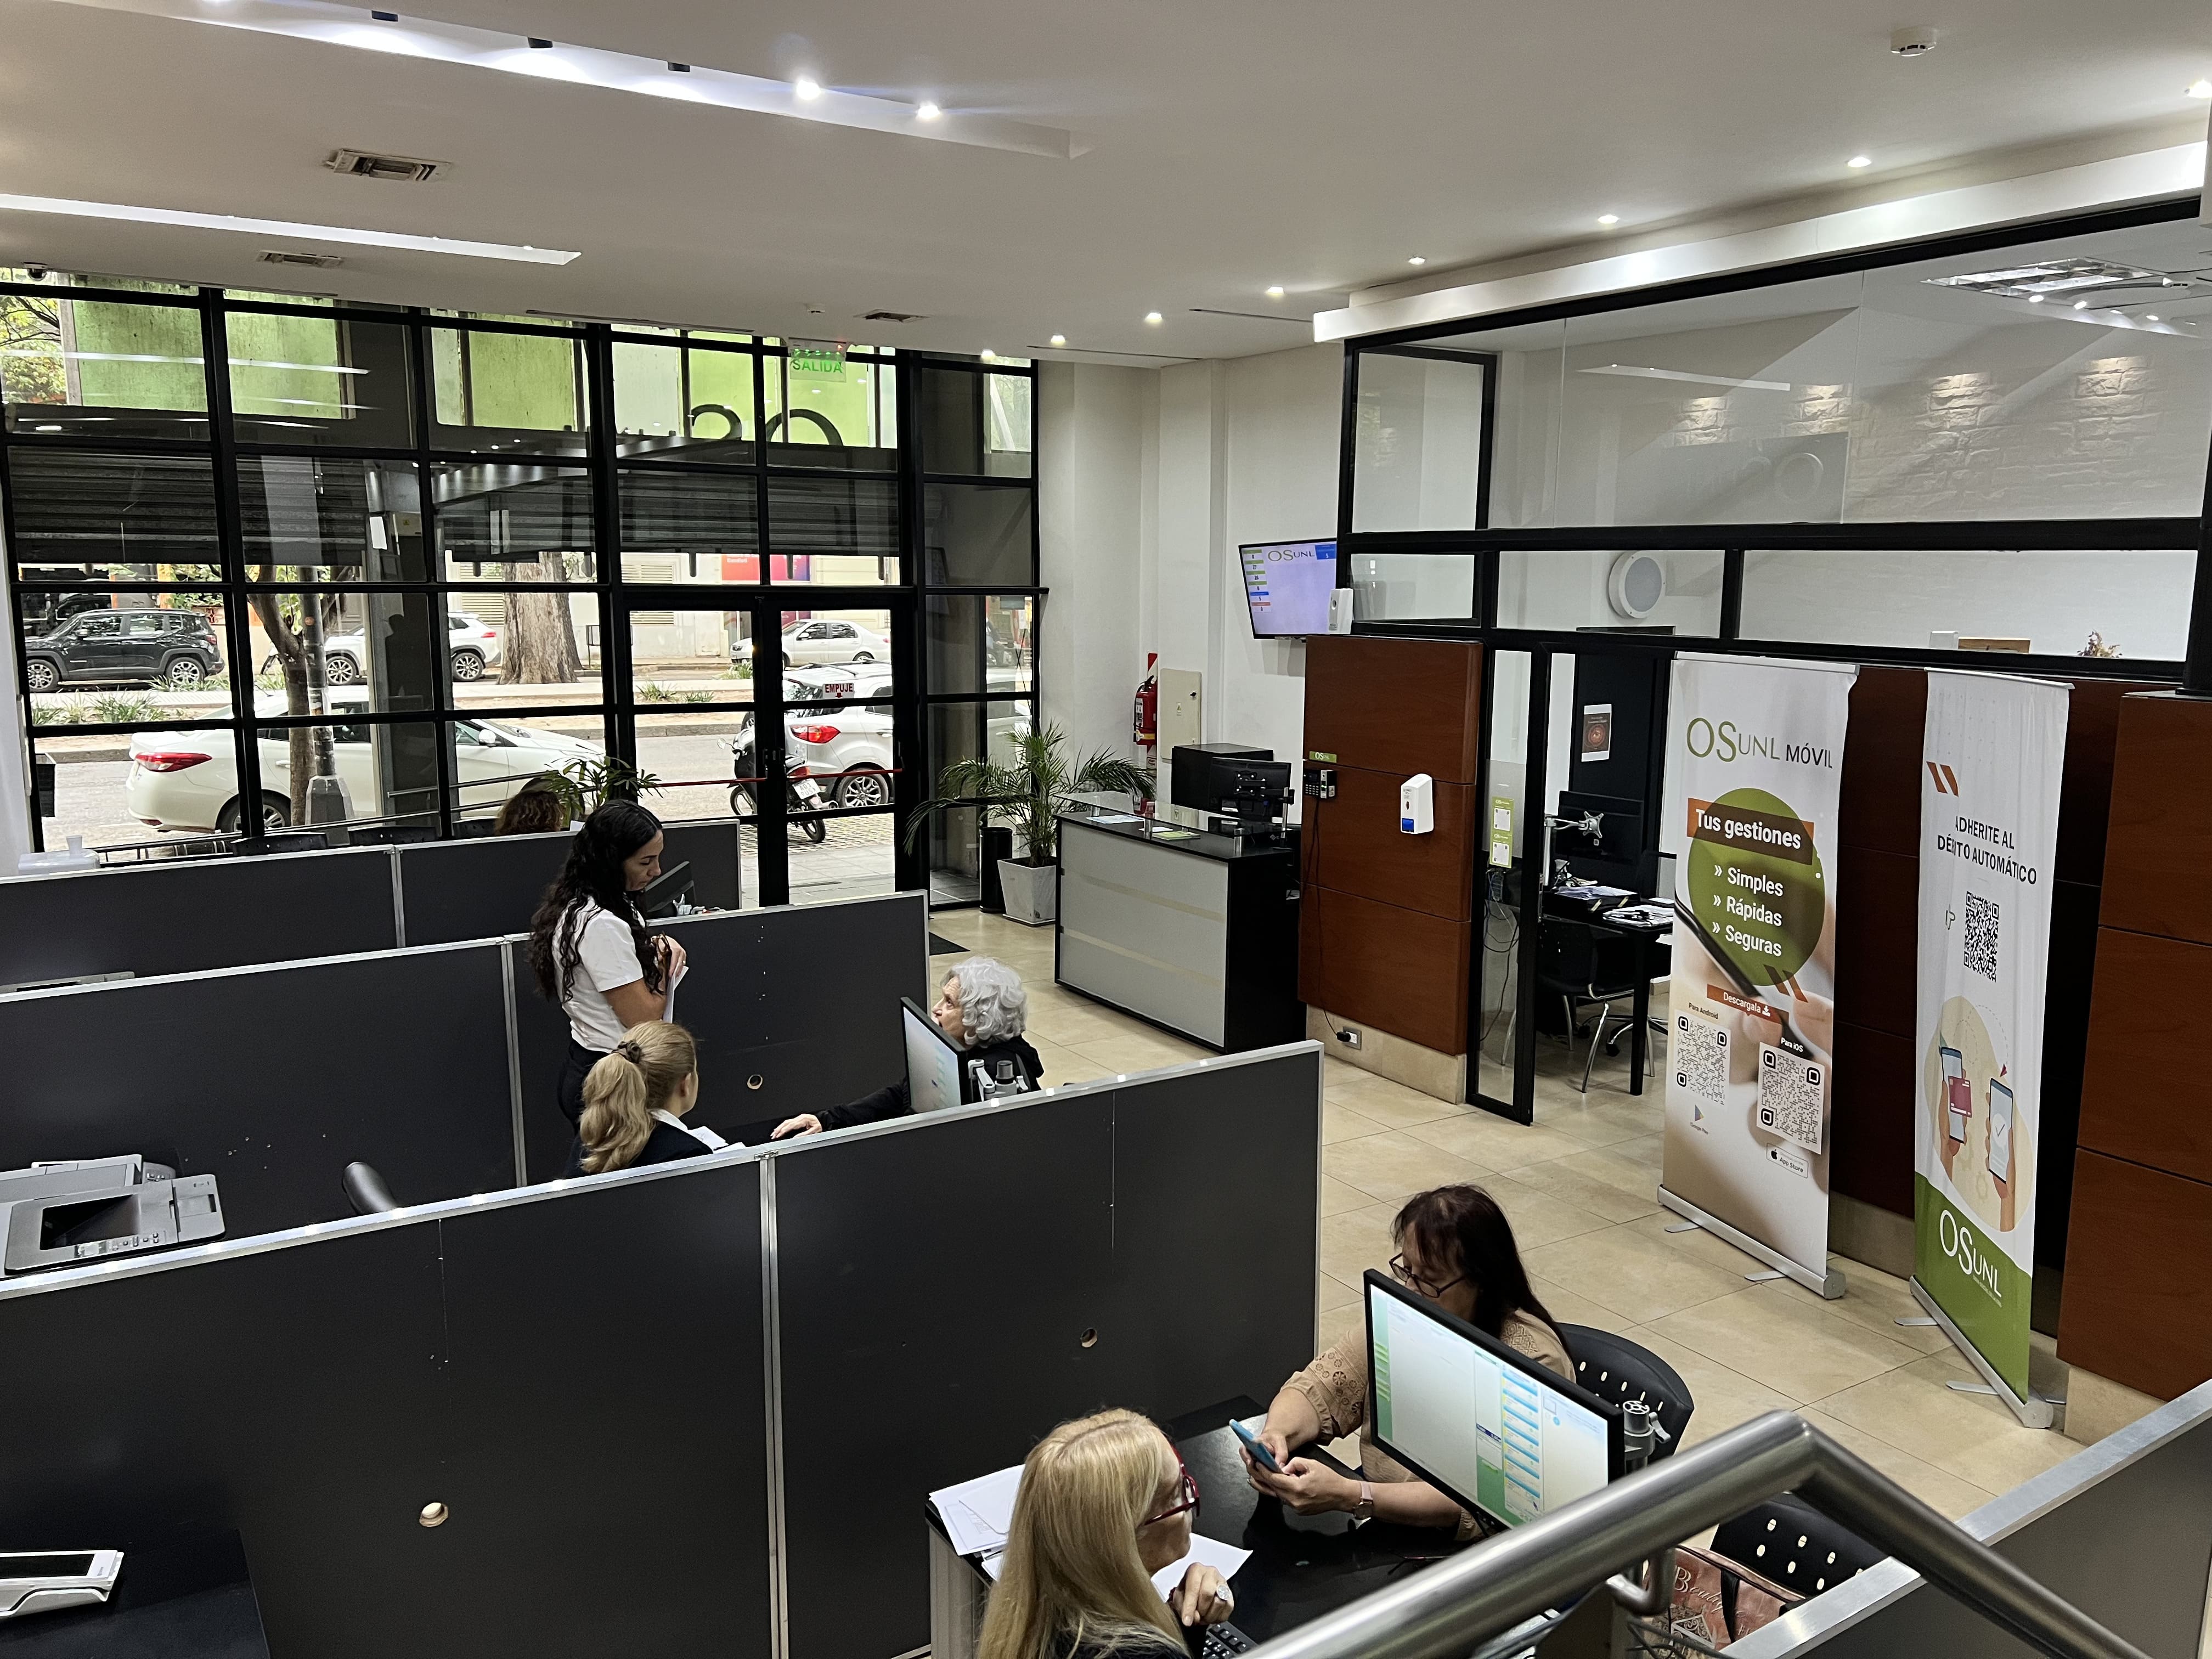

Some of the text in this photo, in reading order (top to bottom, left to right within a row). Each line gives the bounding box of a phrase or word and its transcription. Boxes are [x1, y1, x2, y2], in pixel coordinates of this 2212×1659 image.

[792, 359, 843, 373] SALIDA
[1268, 550, 1314, 562] OSUNL
[825, 683, 853, 693] EMPUJE
[1687, 718, 1832, 769] OSUNL MÓVIL
[1696, 809, 1801, 849] Tus gestiones
[2002, 831, 2015, 850] AL
[1938, 833, 2036, 884] DÉITO AUTOMÁTICO
[1728, 867, 1784, 897] Simples
[1726, 895, 1782, 927] Rápidas
[1725, 925, 1782, 957] Seguras
[1689, 1002, 1718, 1019] Para Android
[1723, 991, 1761, 1014] Descargala
[1781, 1037, 1803, 1052] Para iOS
[1780, 1157, 1789, 1166] App
[1790, 1163, 1804, 1173] Store
[1940, 1210, 2001, 1298] OSUNL
